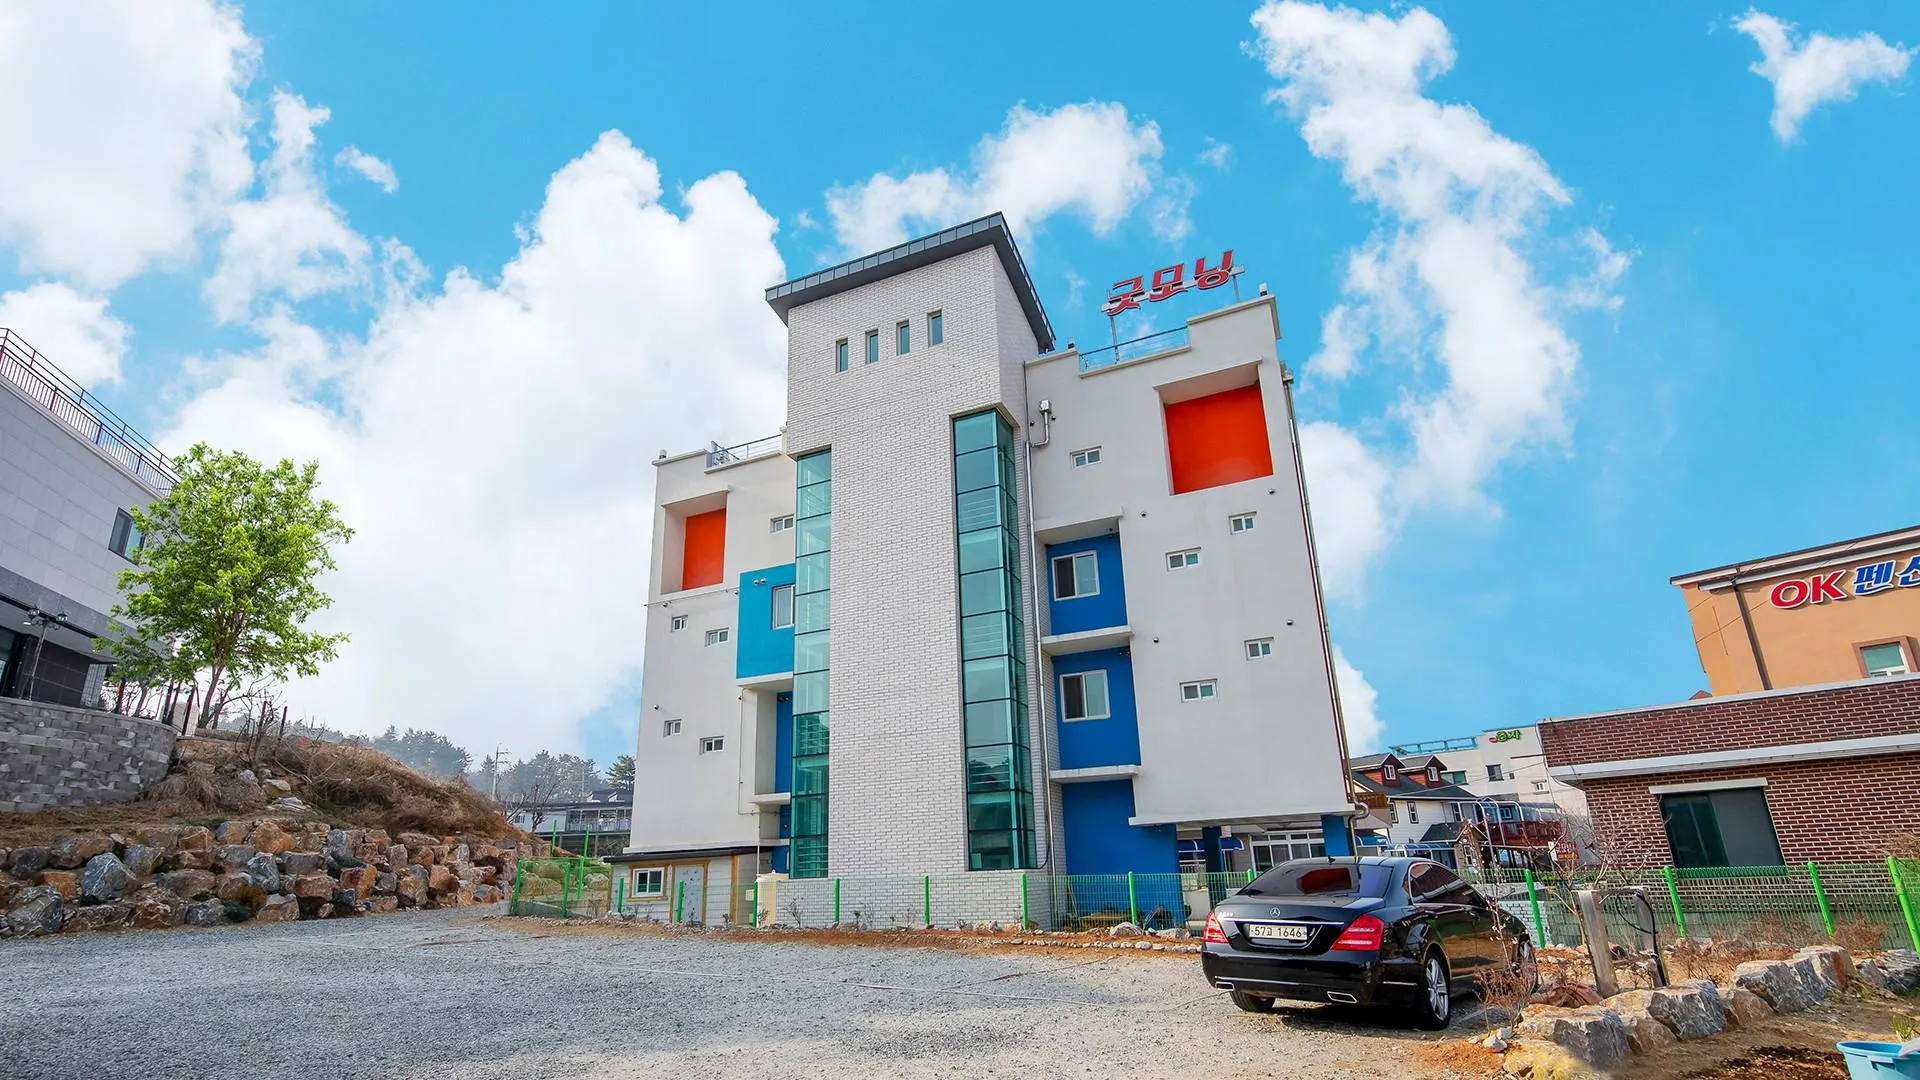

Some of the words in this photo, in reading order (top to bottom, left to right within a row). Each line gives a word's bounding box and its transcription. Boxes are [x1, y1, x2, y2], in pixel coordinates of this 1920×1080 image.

[1106, 249, 1233, 316] 굿모닝
[1770, 569, 1847, 609] OK
[1278, 927, 1302, 938] 1646
